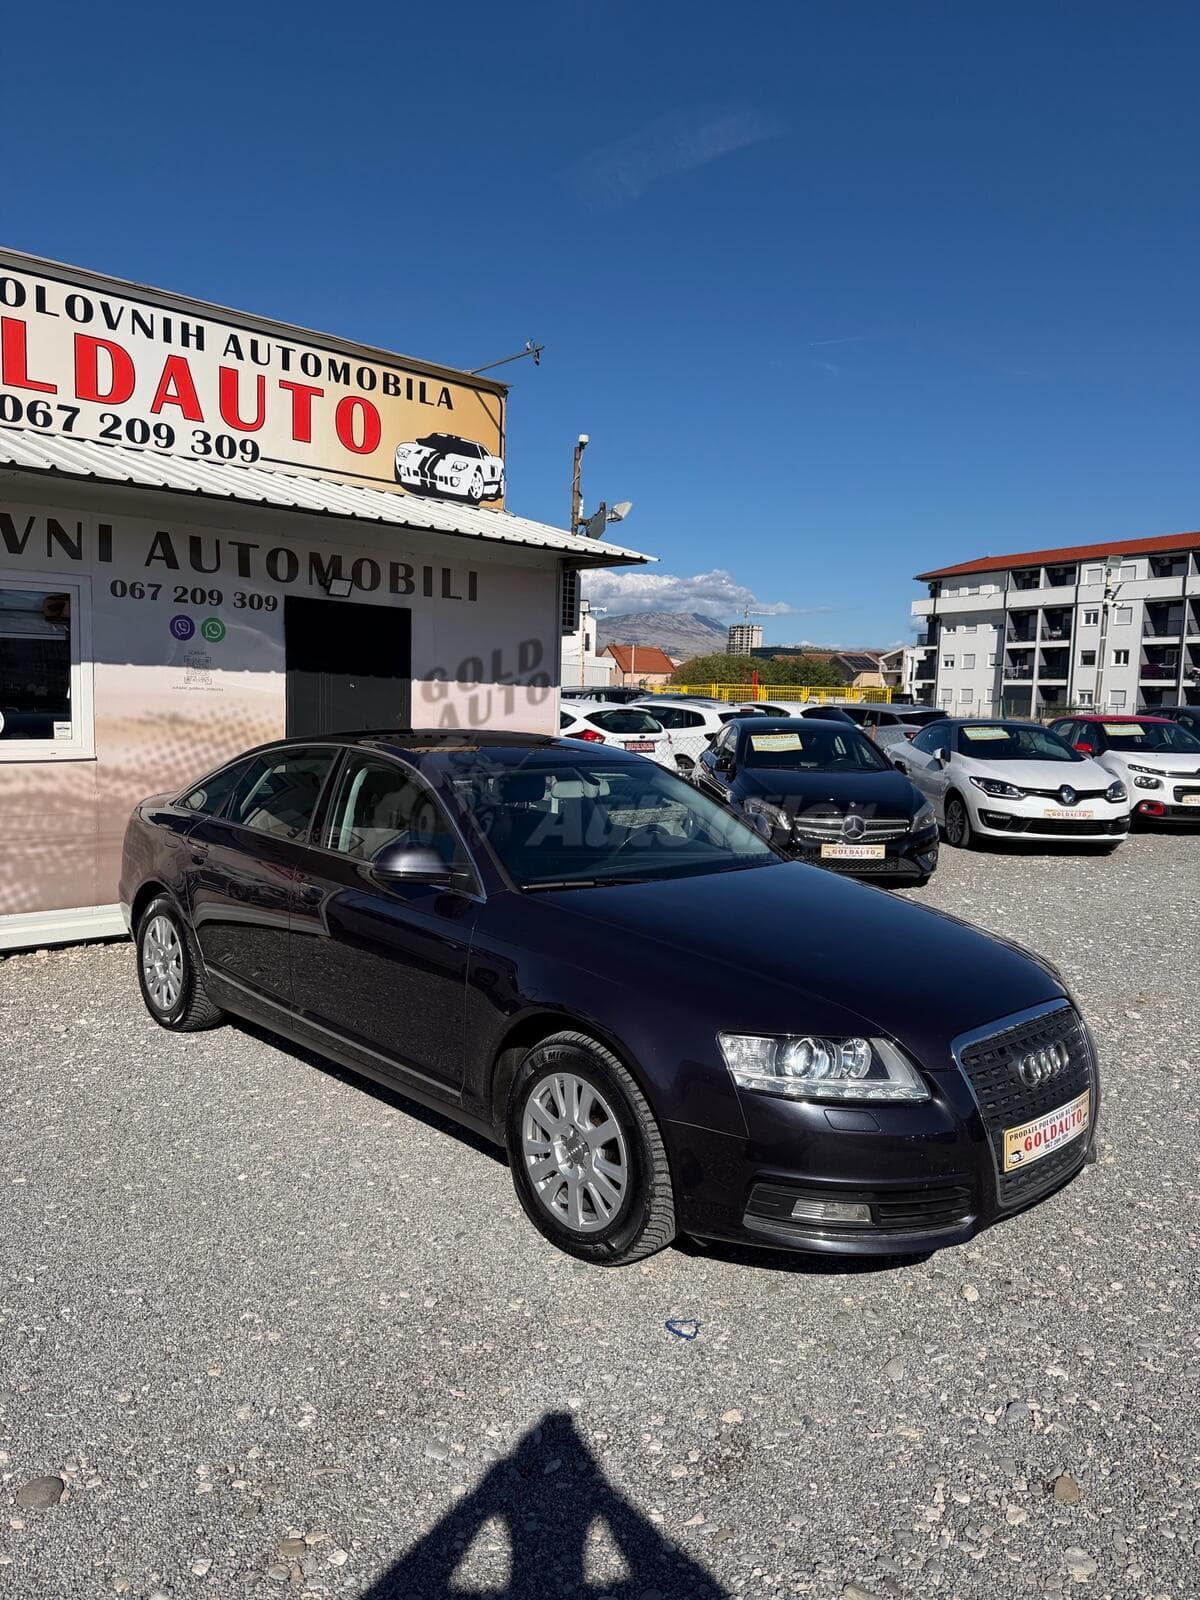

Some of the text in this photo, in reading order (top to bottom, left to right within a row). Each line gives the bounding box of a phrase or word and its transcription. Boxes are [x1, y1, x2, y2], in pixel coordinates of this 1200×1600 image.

[0, 277, 454, 411] OLOVNIH AUTOMOBILA
[0, 315, 382, 455] LDAUTO
[0, 393, 260, 463] 067 209 309
[0, 512, 478, 602] VNI AUTOMOBILI
[109, 579, 279, 612] 067 209 309
[420, 637, 544, 703] GOLD
[437, 671, 551, 729] AUTO
[832, 848, 876, 856] GOLDAUTO
[1024, 1108, 1083, 1152] GOLDAUTO
